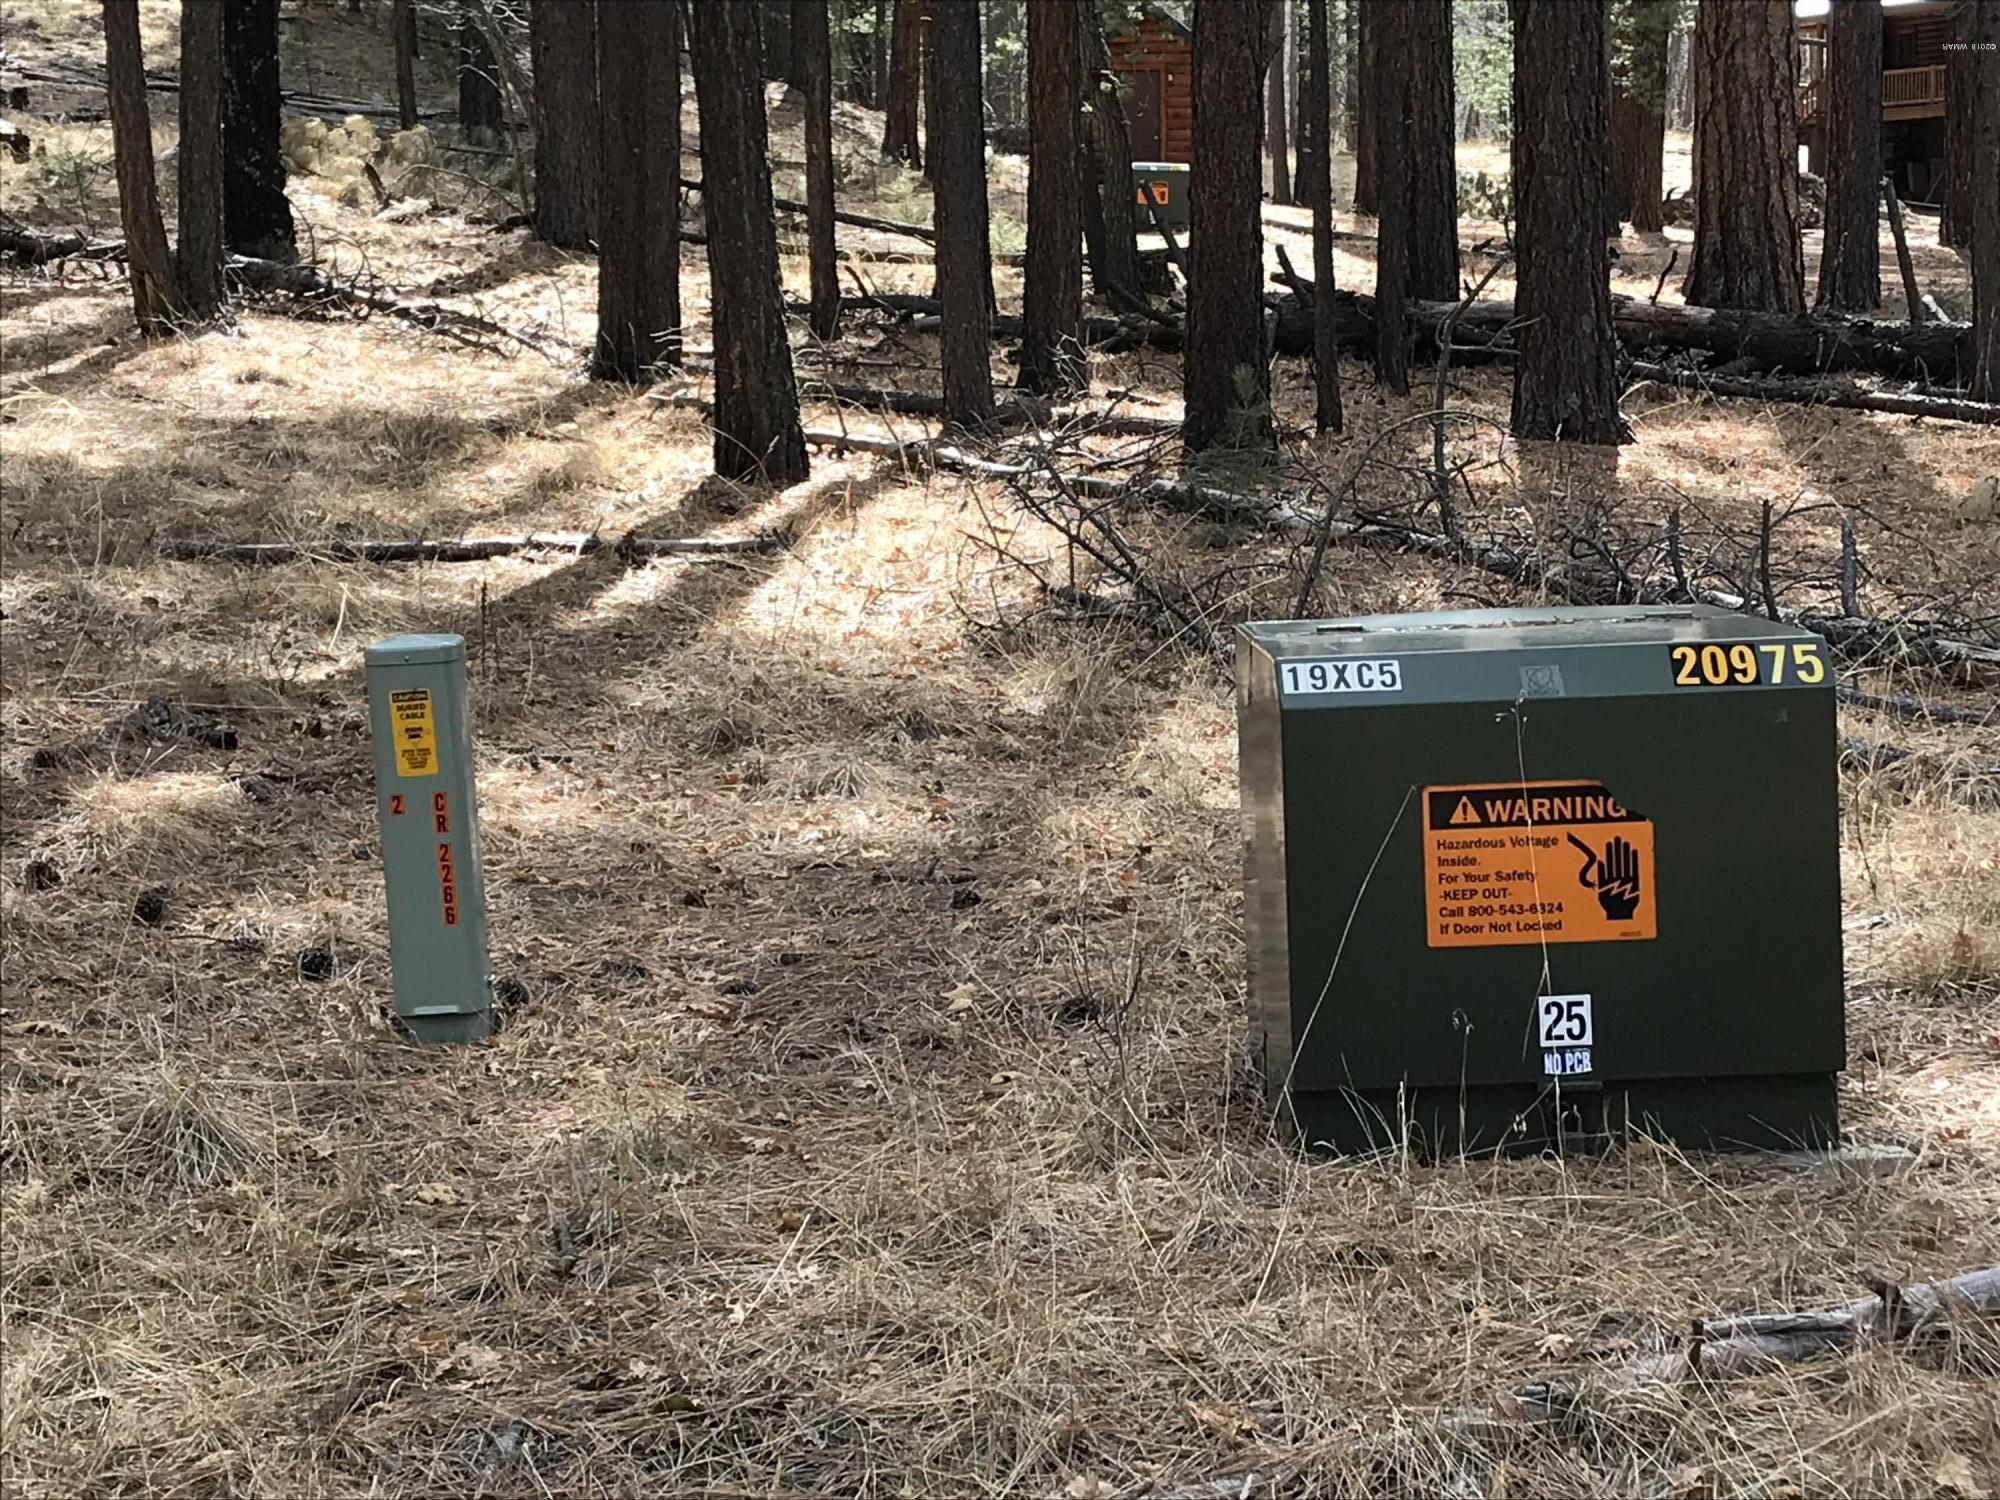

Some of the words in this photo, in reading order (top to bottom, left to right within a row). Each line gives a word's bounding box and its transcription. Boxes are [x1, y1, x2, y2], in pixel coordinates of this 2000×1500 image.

[1672, 644, 1824, 685] 20975
[1287, 663, 1397, 691] 19XC5
[391, 795, 402, 814] 2
[1485, 796, 1627, 823] WARNING
[1437, 837, 1506, 850] Hazardous
[1437, 856, 1481, 867] Inside.
[440, 844, 455, 924] 2266
[1438, 873, 1459, 884] For
[1462, 871, 1491, 883] Your
[1494, 869, 1537, 883] Safety
[1440, 890, 1479, 900] -KEEP
[1439, 906, 1464, 918] Call
[1440, 923, 1450, 935] If
[1453, 923, 1484, 934] Door
[1489, 921, 1512, 933] Not
[1544, 1001, 1587, 1041] 25
[1544, 1052, 1562, 1074] NO
[1565, 1051, 1592, 1073] PCB
